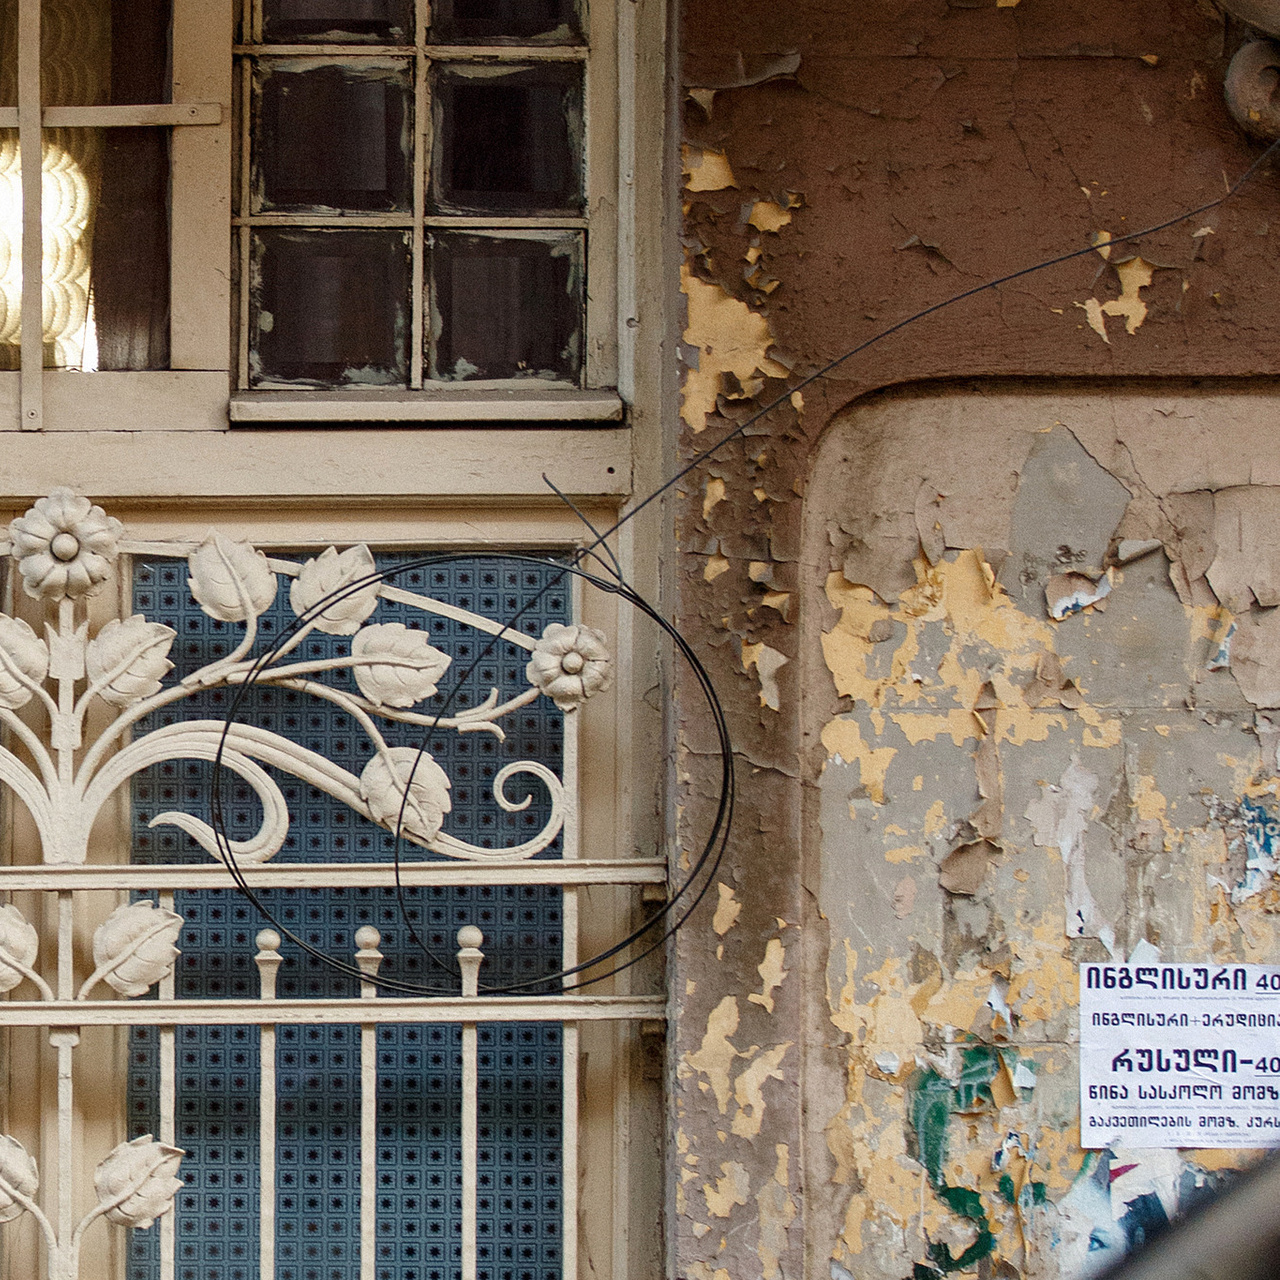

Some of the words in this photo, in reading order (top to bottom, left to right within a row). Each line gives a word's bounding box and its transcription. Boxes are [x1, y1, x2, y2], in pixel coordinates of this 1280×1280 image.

[1086, 966, 1247, 990] ინგლისური
[1088, 1084, 1128, 1100] წინა
[1138, 1084, 1222, 1100] სასკოლო
[1089, 1115, 1192, 1128] გაკვეთილების
